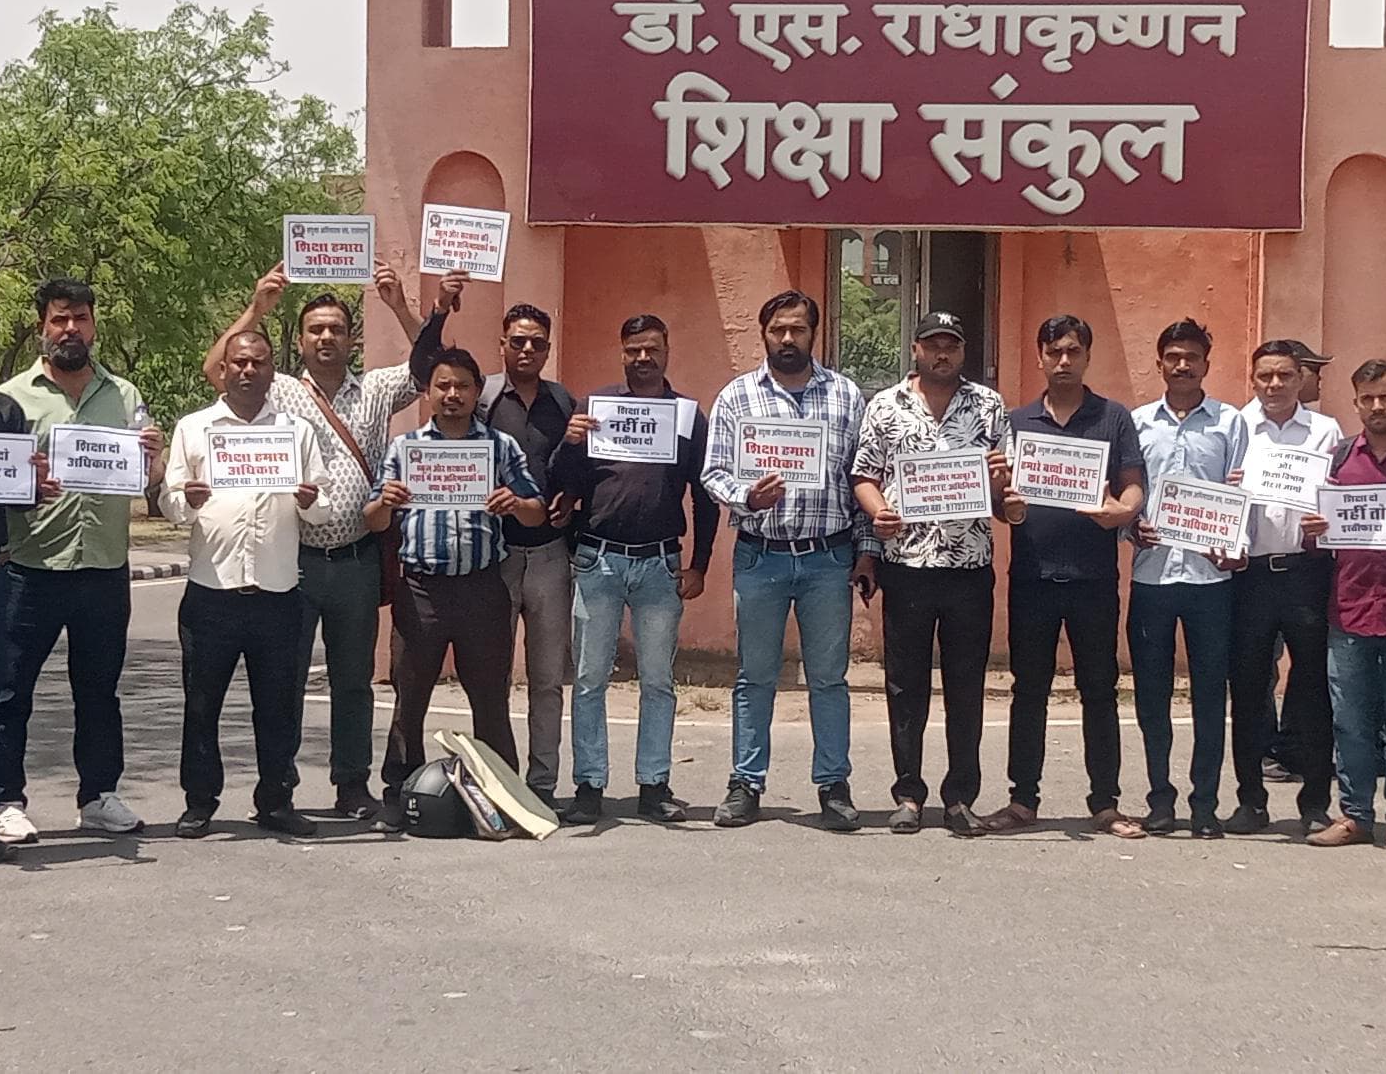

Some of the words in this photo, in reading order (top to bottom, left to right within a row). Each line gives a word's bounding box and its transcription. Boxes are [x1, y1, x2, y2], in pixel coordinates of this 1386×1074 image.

[729, 2, 860, 74] एस.
[871, 3, 1246, 74] राधाकृष्णन
[651, 71, 900, 199] शिक्षा
[917, 74, 1201, 216] संकुल
[295, 240, 328, 252] शिक्षा
[331, 243, 363, 253] हमारा
[305, 254, 354, 265] अधिकार
[609, 417, 639, 433] नहीं
[640, 418, 658, 434] तो
[75, 439, 106, 453] शिक्षा
[108, 442, 120, 454] दो
[745, 442, 779, 455] शिक्षा
[780, 446, 815, 457] हमारा
[67, 456, 113, 470] अधिकार
[116, 458, 128, 470] दो
[216, 452, 251, 462] शिक्षा
[254, 453, 289, 462] हमारा
[755, 456, 804, 469] अधिकार
[4, 466, 17, 478] दो
[228, 464, 279, 475] अधिकार
[1021, 460, 1041, 472] हमारे
[1064, 465, 1077, 476] को
[1079, 468, 1099, 479] RTE
[1027, 474, 1039, 484] का
[1042, 475, 1077, 489] अधिकार
[1343, 494, 1367, 503] शिक्षा
[1368, 493, 1378, 502] दो
[1161, 502, 1181, 514] हमारे
[1205, 510, 1218, 522] को
[1219, 513, 1240, 526] RTE
[1336, 504, 1369, 521] नहीं
[1369, 504, 1386, 520] तो
[1167, 515, 1179, 526] का
[1181, 518, 1217, 534] अधिकार
